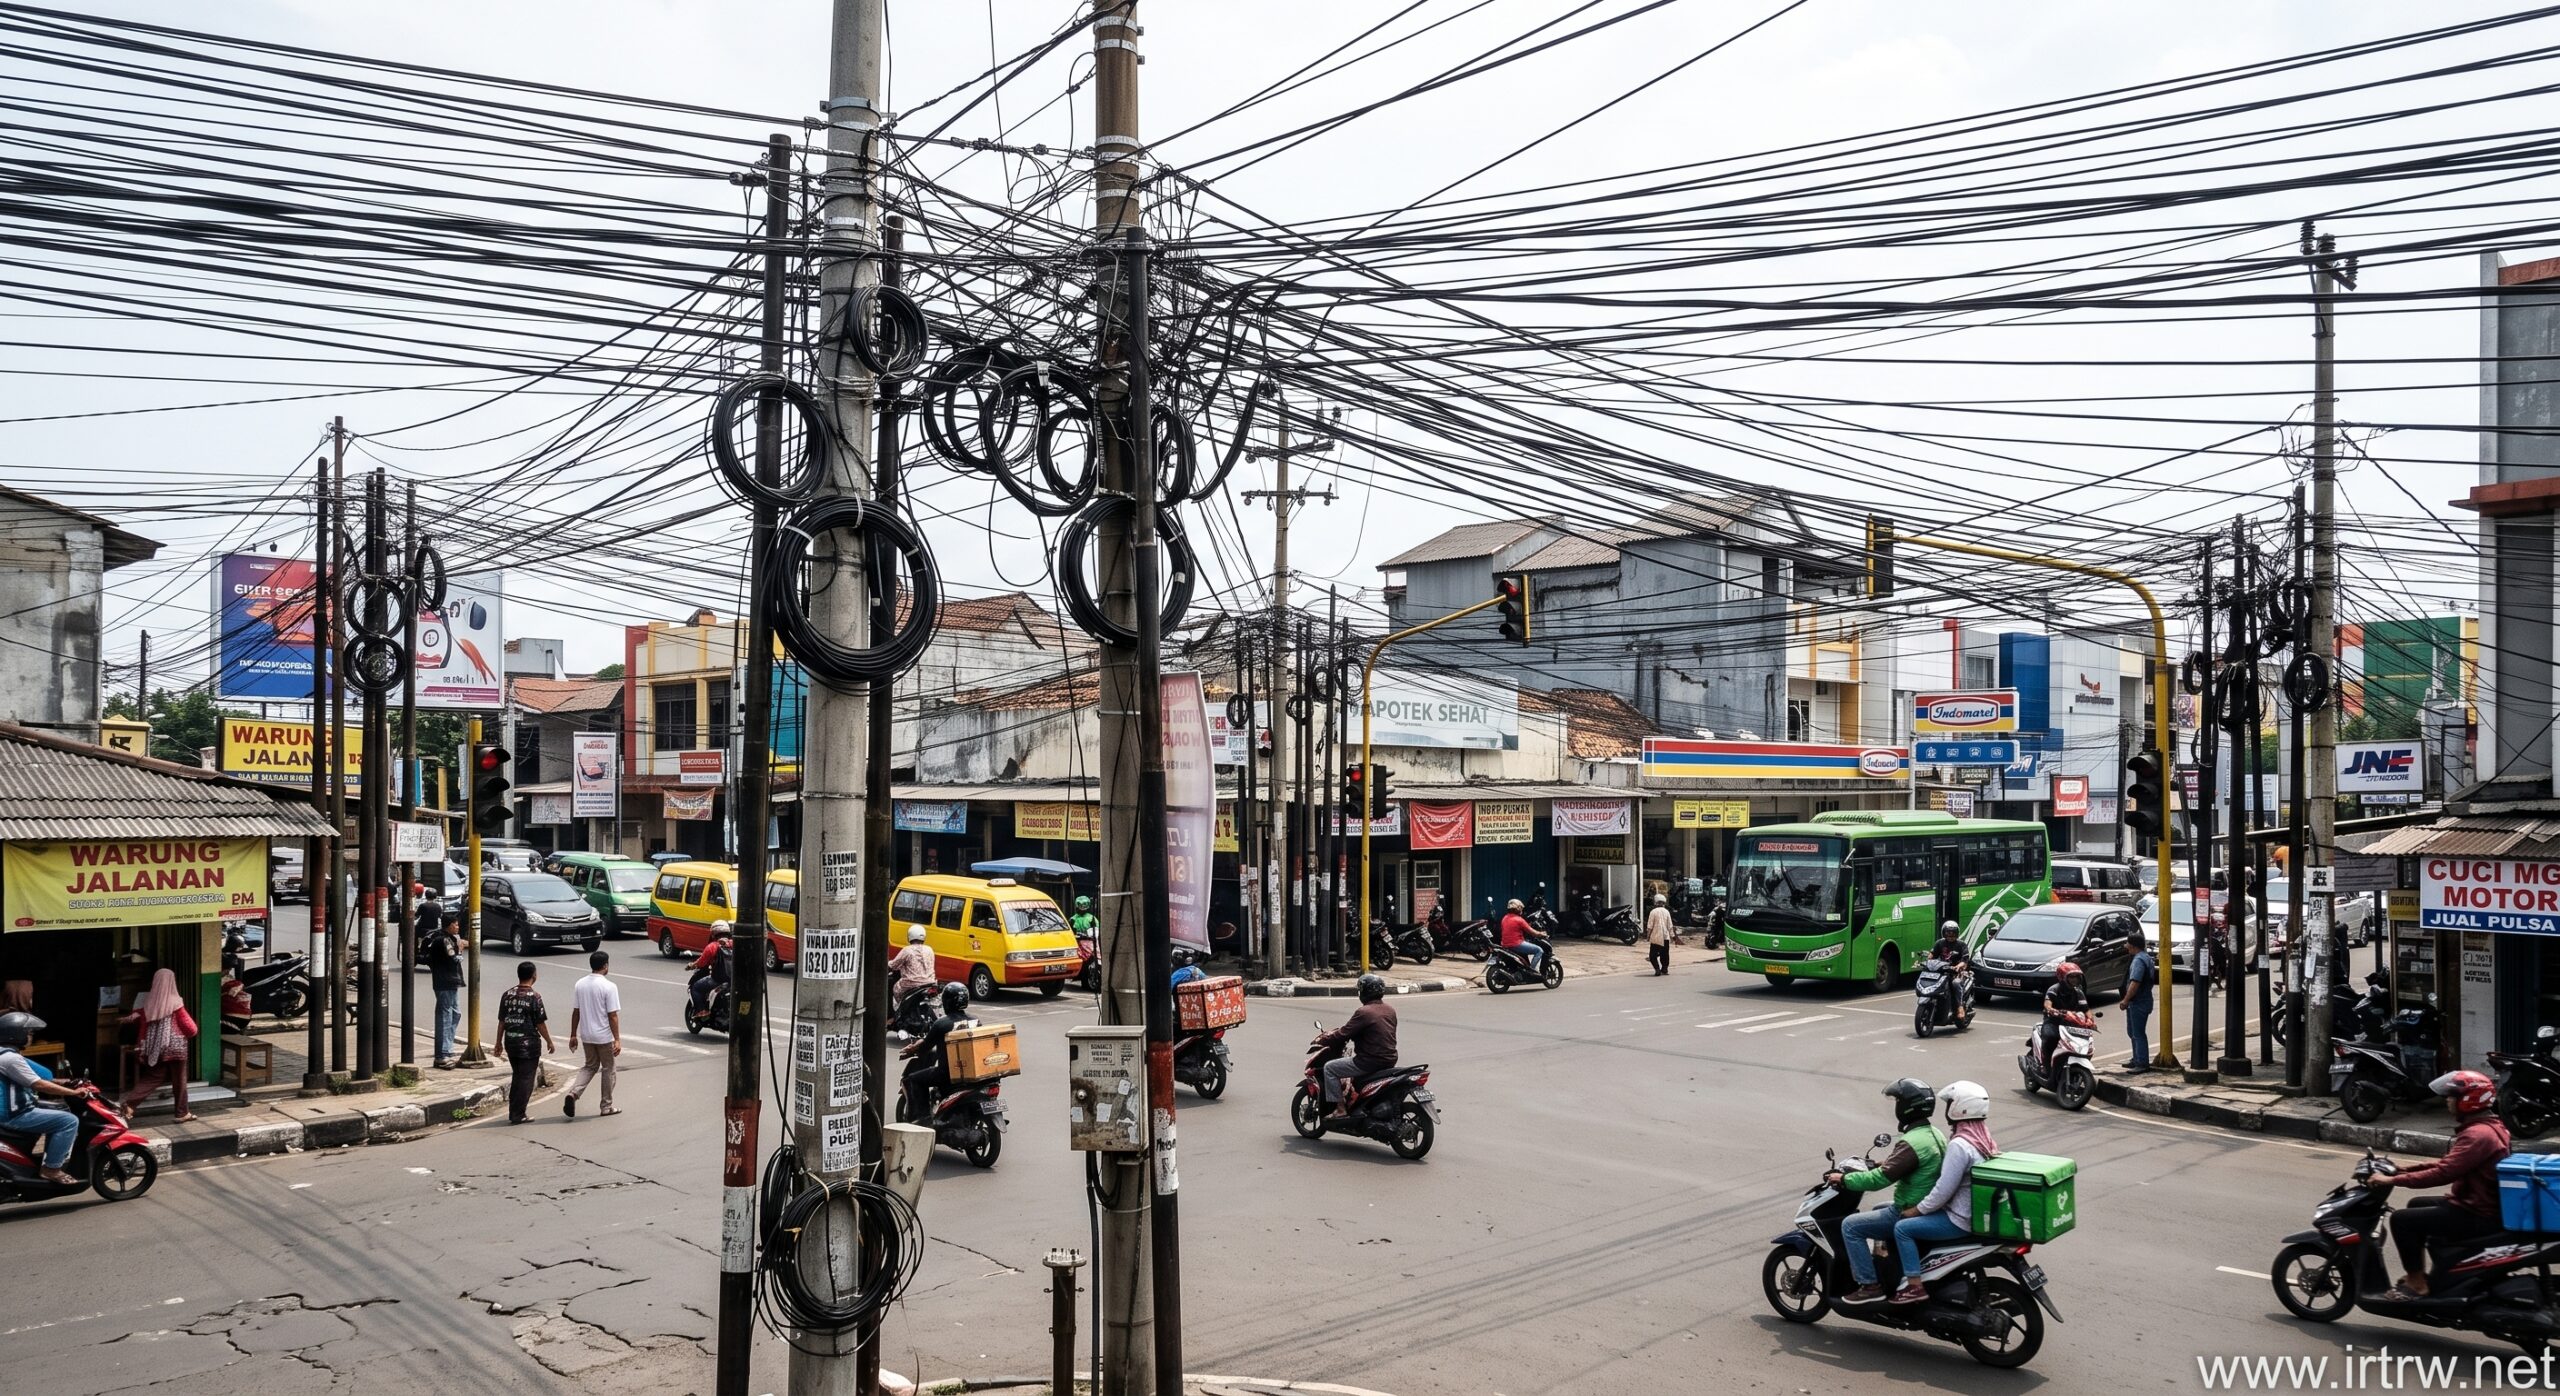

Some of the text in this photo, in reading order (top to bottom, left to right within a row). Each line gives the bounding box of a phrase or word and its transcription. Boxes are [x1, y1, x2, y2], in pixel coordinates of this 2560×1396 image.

[1360, 700, 1489, 724] APOTEK SEHAT
[2341, 749, 2415, 774] JNE
[69, 841, 220, 867] WARUNG
[66, 867, 225, 894] JALANAN
[2427, 859, 2502, 883] CUCI
[2444, 886, 2559, 911] MOTOR
[2430, 912, 2556, 931] JUAL PULSA
